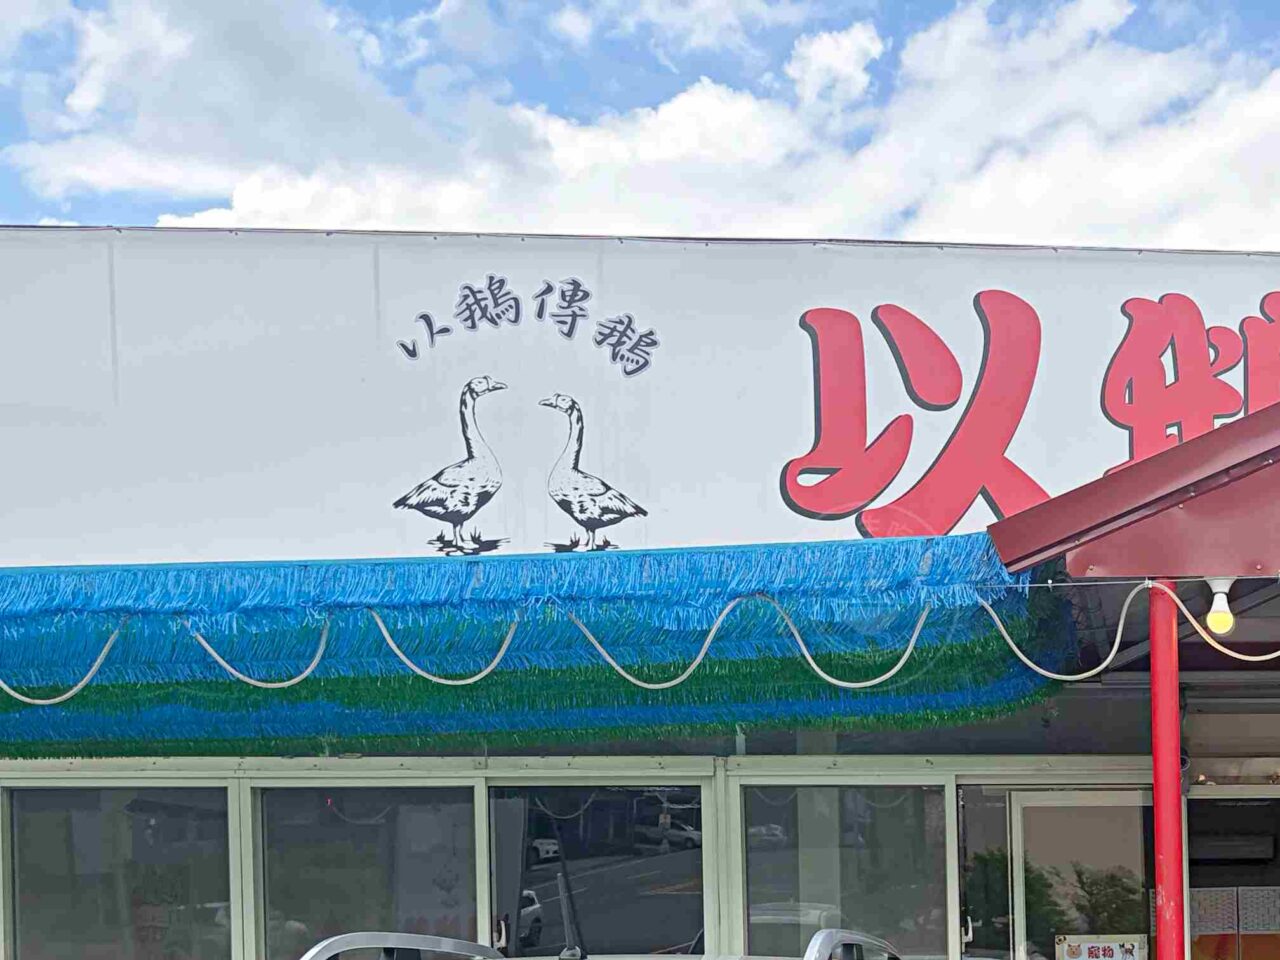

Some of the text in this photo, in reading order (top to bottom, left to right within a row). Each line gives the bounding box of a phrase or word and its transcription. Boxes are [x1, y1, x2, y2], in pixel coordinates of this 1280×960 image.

[396, 274, 659, 377] 以鵝傳鵝
[1087, 945, 1114, 959] 寵物
